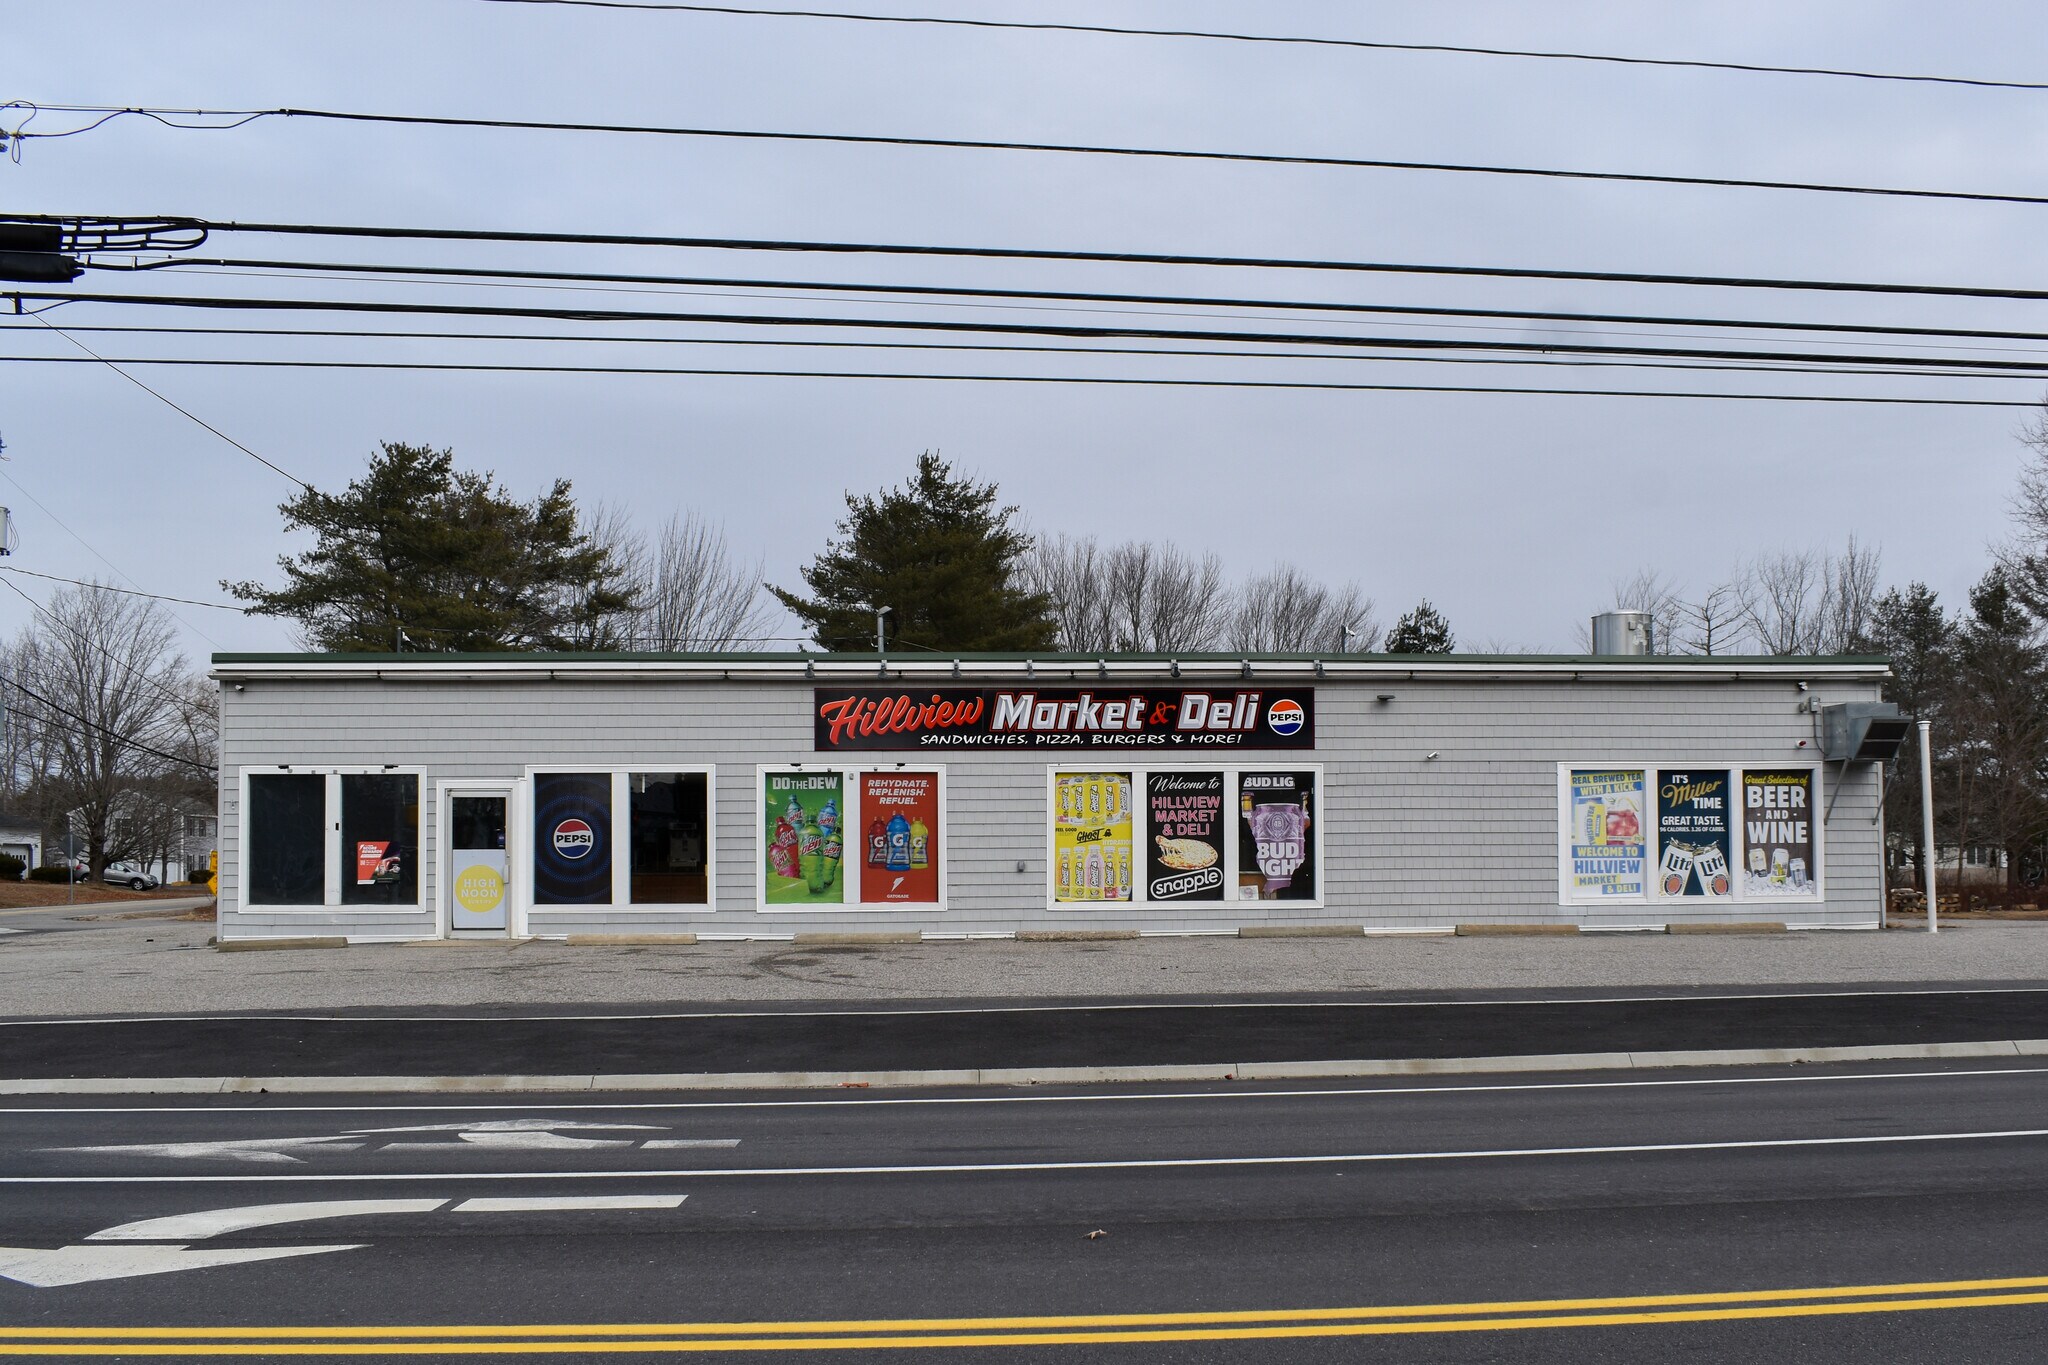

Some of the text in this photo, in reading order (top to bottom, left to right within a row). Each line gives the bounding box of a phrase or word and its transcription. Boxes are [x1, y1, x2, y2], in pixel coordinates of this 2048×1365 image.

[820, 693, 1261, 745] Hillview Market & Deli
[1270, 713, 1302, 721] PEPSI
[920, 734, 1242, 745] SANDWICHES, PIZZA, BURGERS & MORE!
[772, 777, 838, 790] DO THE DEW
[867, 780, 929, 788] REHYDRATE.
[1149, 775, 1221, 792] Welcome to
[1243, 776, 1295, 787] BUD LIG
[1572, 772, 1641, 785] REAL BREWED TEA
[1672, 775, 1688, 784] IT'S
[1745, 775, 1808, 786] Great Selection of
[868, 788, 926, 796] REPLENISH.
[1580, 786, 1604, 796] WITH
[1605, 785, 1612, 793] A
[1661, 780, 1722, 808] Miller
[879, 797, 918, 805] REFUEL.
[1151, 795, 1221, 809] HILLVIEW
[1747, 785, 1806, 808] BEER
[1155, 809, 1218, 822] MARKET
[1765, 810, 1789, 820] AND
[1662, 816, 1723, 826] GREAT TASTE.
[1162, 823, 1210, 836] & DELI
[1747, 821, 1807, 843] WINE
[556, 834, 591, 843] PEPSI
[873, 836, 884, 847] G
[892, 834, 904, 847] G
[1077, 828, 1104, 844] GHOST
[913, 837, 923, 848] G
[1256, 842, 1299, 859] BUD
[1577, 847, 1638, 857] WELCOME TO
[1574, 860, 1640, 874] HILLVIEW
[1666, 853, 1692, 872] Lite
[1699, 855, 1724, 877] Lite
[463, 879, 496, 887] HIGH
[1155, 869, 1219, 894] snapple
[1579, 875, 1617, 886] MARKET
[461, 889, 498, 898] NOON
[1607, 884, 1637, 893] & DELI
